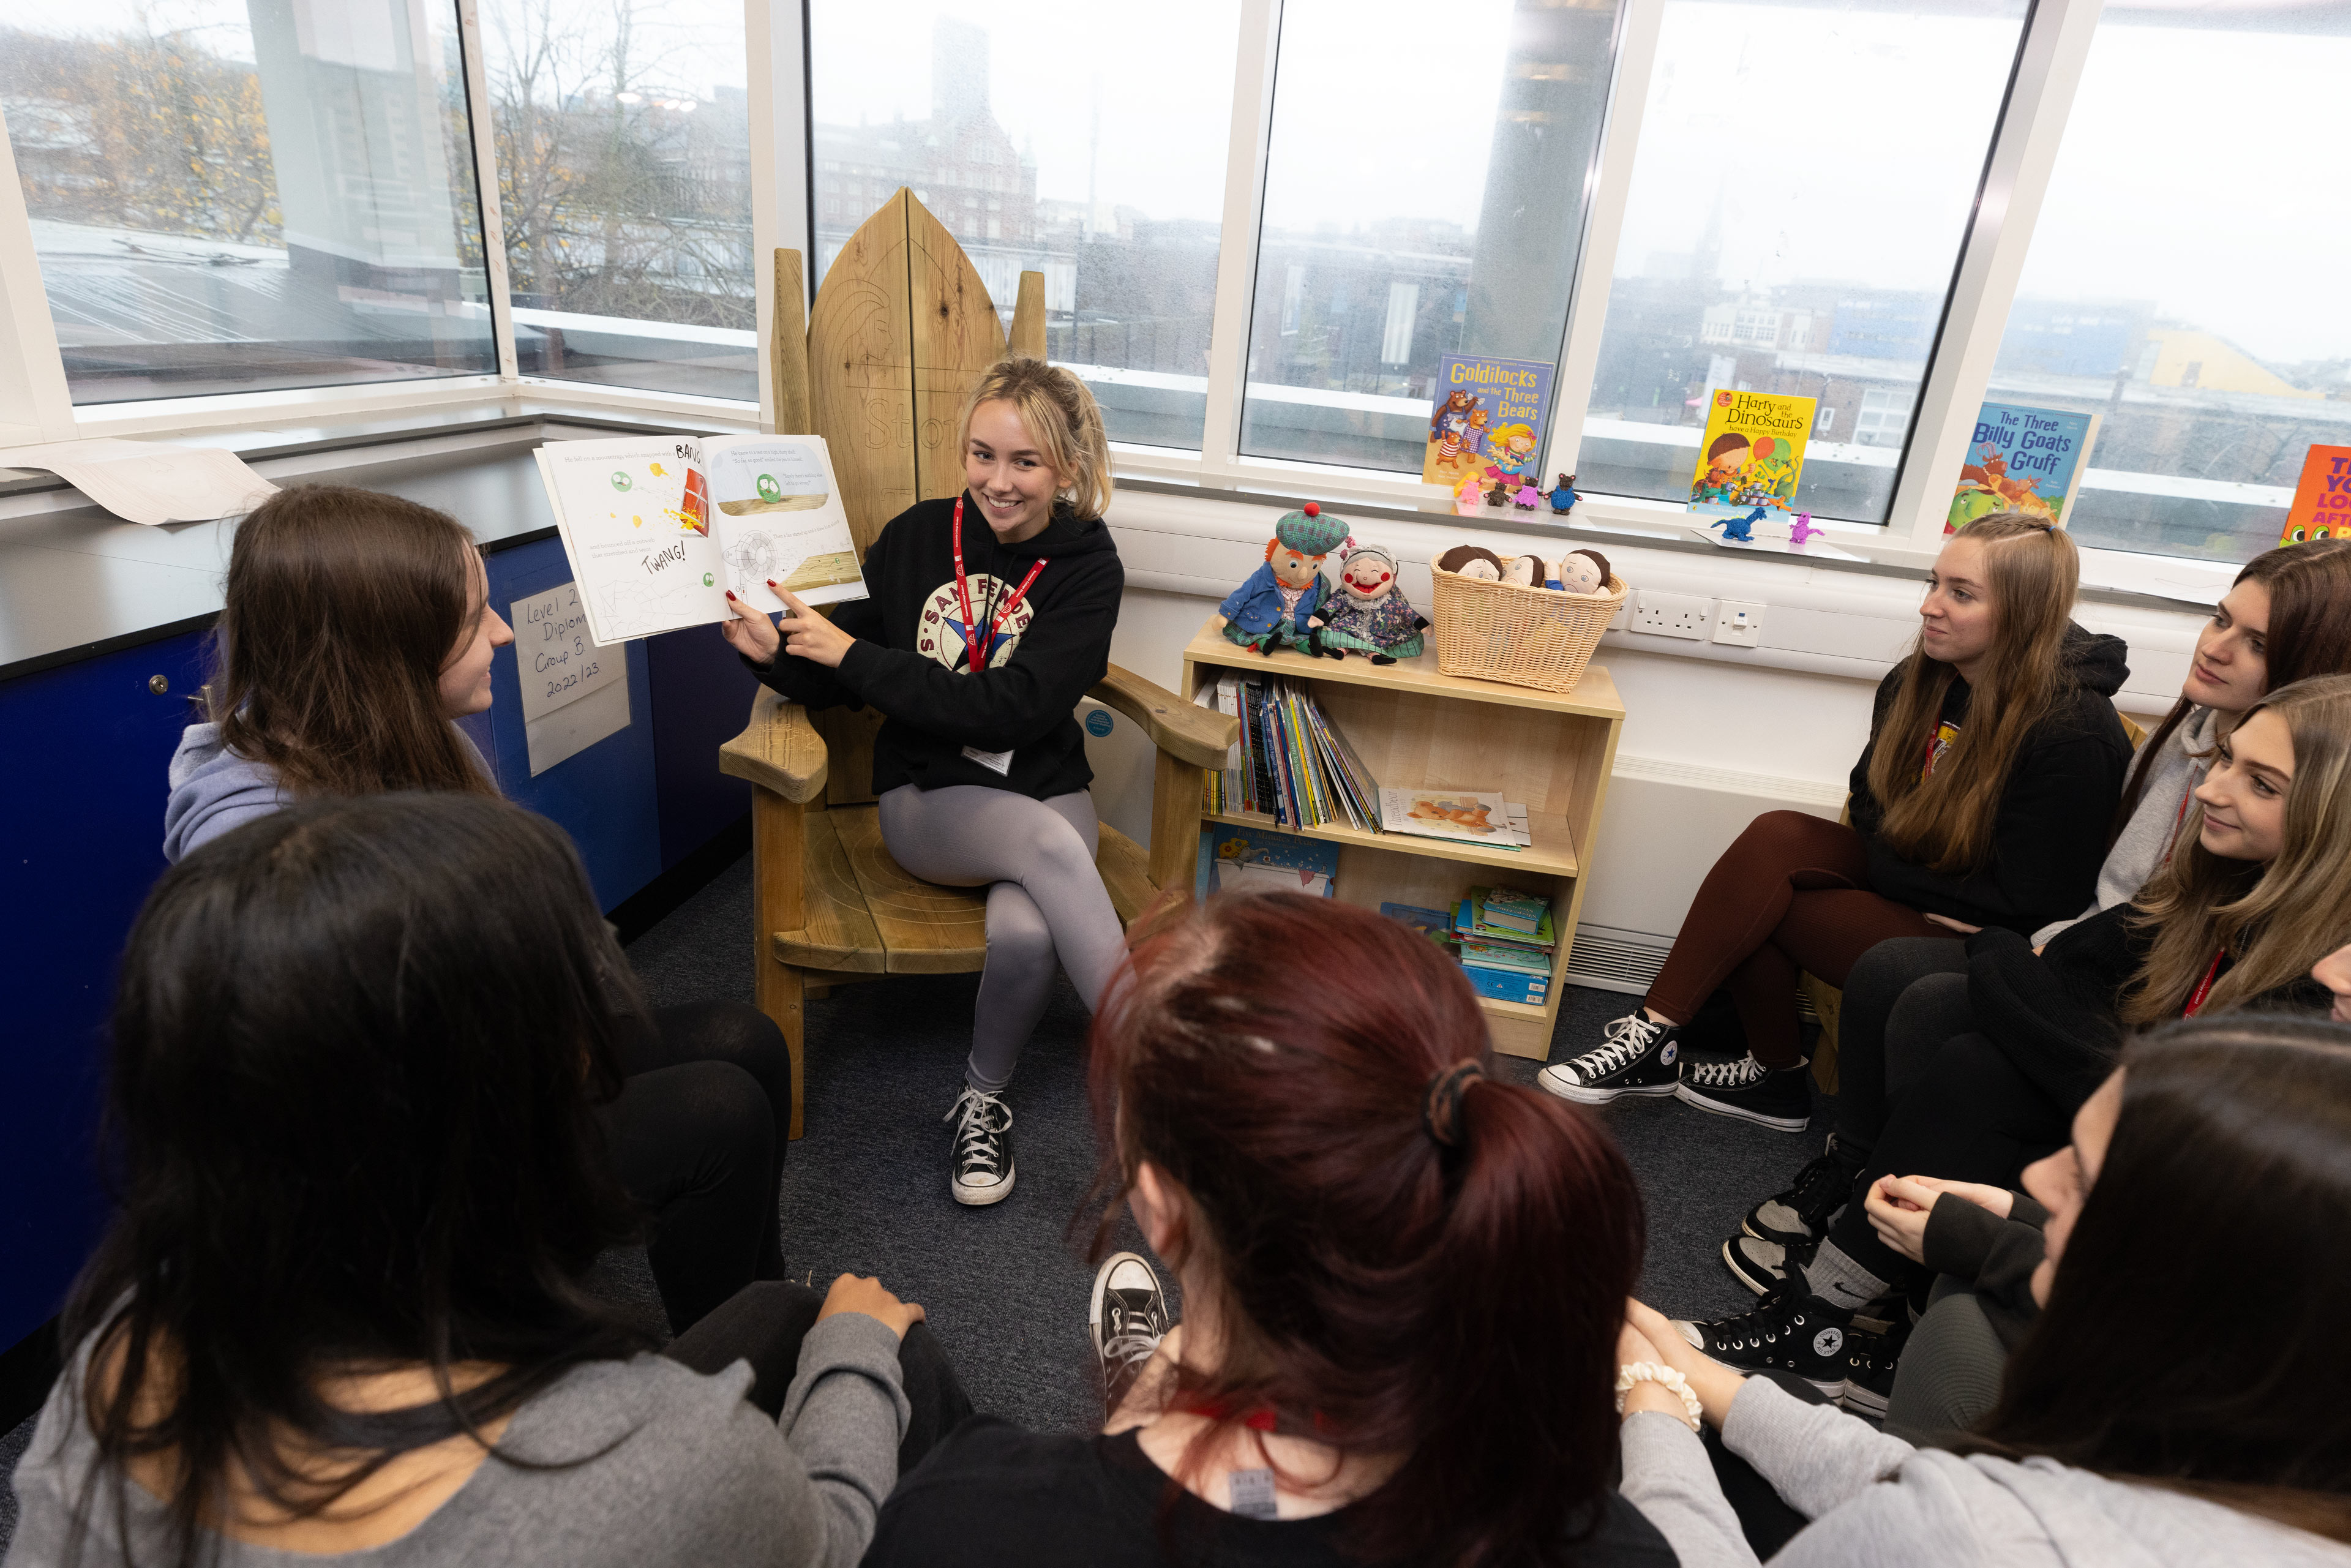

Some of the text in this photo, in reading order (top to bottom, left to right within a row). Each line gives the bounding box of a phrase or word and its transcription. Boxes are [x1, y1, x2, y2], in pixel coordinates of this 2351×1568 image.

[1450, 363, 1537, 388] Goldilocks
[1491, 386, 1501, 396] the
[1504, 387, 1539, 403] Three
[1738, 394, 1775, 416] Harry
[1498, 401, 1538, 421] Bears
[1725, 408, 1804, 429] Dinosaurs
[2000, 411, 2019, 426] The
[2024, 415, 2059, 432] Three
[865, 398, 962, 449] Stor
[1750, 426, 1770, 437] Happy
[1771, 429, 1798, 438] Birthday
[1972, 422, 2072, 452] Billy Goats
[2010, 451, 2061, 475] Gruff
[2317, 493, 2351, 509] LO
[641, 540, 686, 575] TWANG!
[1027, 569, 1037, 582] Newcastle
[527, 589, 578, 625] Level 2
[977, 579, 1030, 637] FENDE
[544, 614, 587, 641] Diplom
[535, 651, 569, 673] Group
[1388, 790, 1402, 826] Threadbear
[1237, 828, 1254, 838] Five
[1293, 836, 1318, 847] Peace
[2194, 991, 2202, 1004] Student
